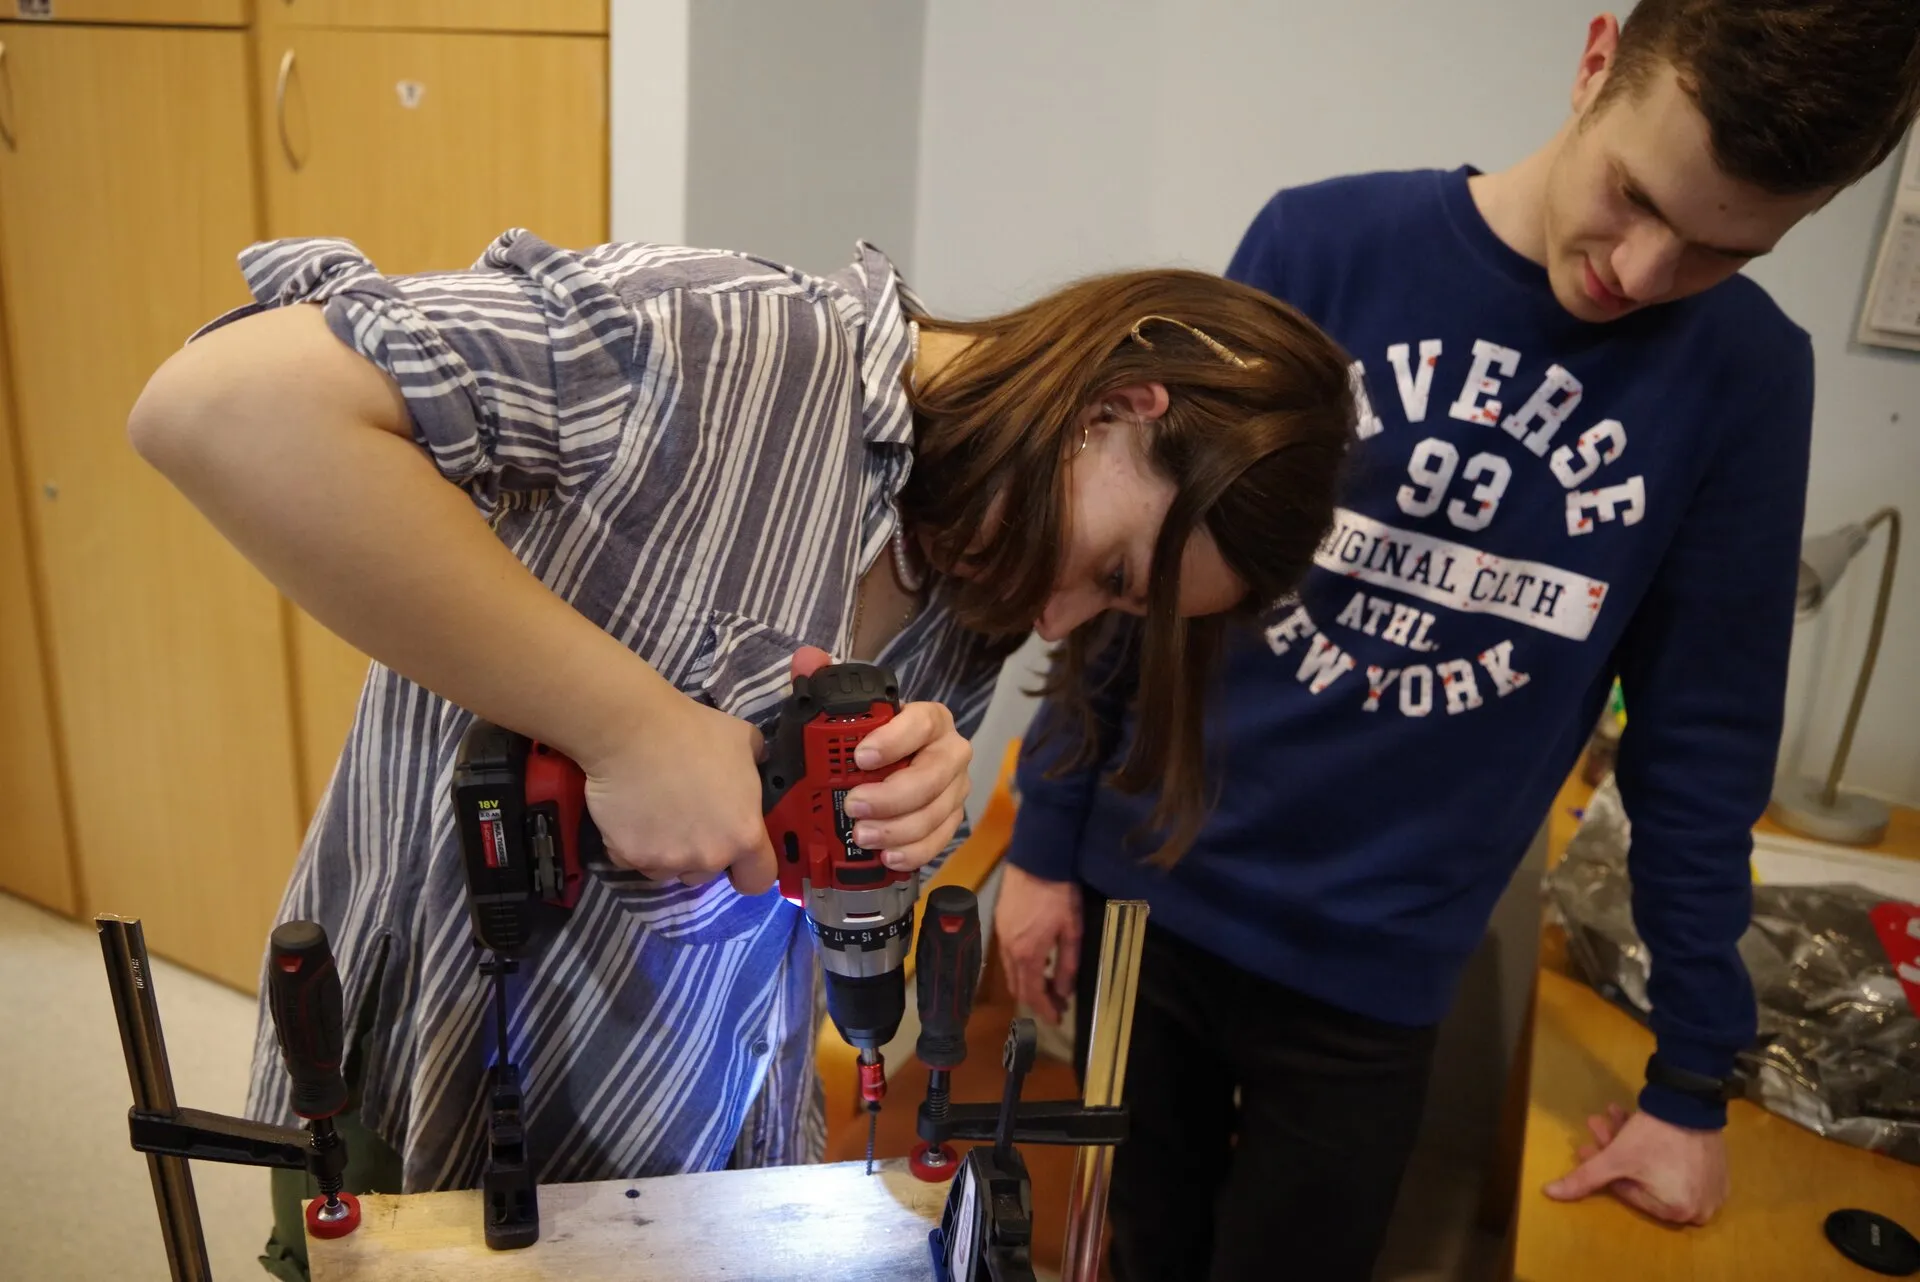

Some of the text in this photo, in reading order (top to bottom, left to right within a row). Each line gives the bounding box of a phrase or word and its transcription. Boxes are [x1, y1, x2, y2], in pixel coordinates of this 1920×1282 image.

[1344, 338, 1646, 537] IVERSE
[1396, 437, 1512, 532] 93
[1328, 523, 1455, 594] IGINAL
[1361, 639, 1531, 717] YORK
[478, 799, 499, 809] 18V
[834, 931, 844, 941] 17
[862, 931, 873, 942] 15
[889, 924, 898, 936] 13
